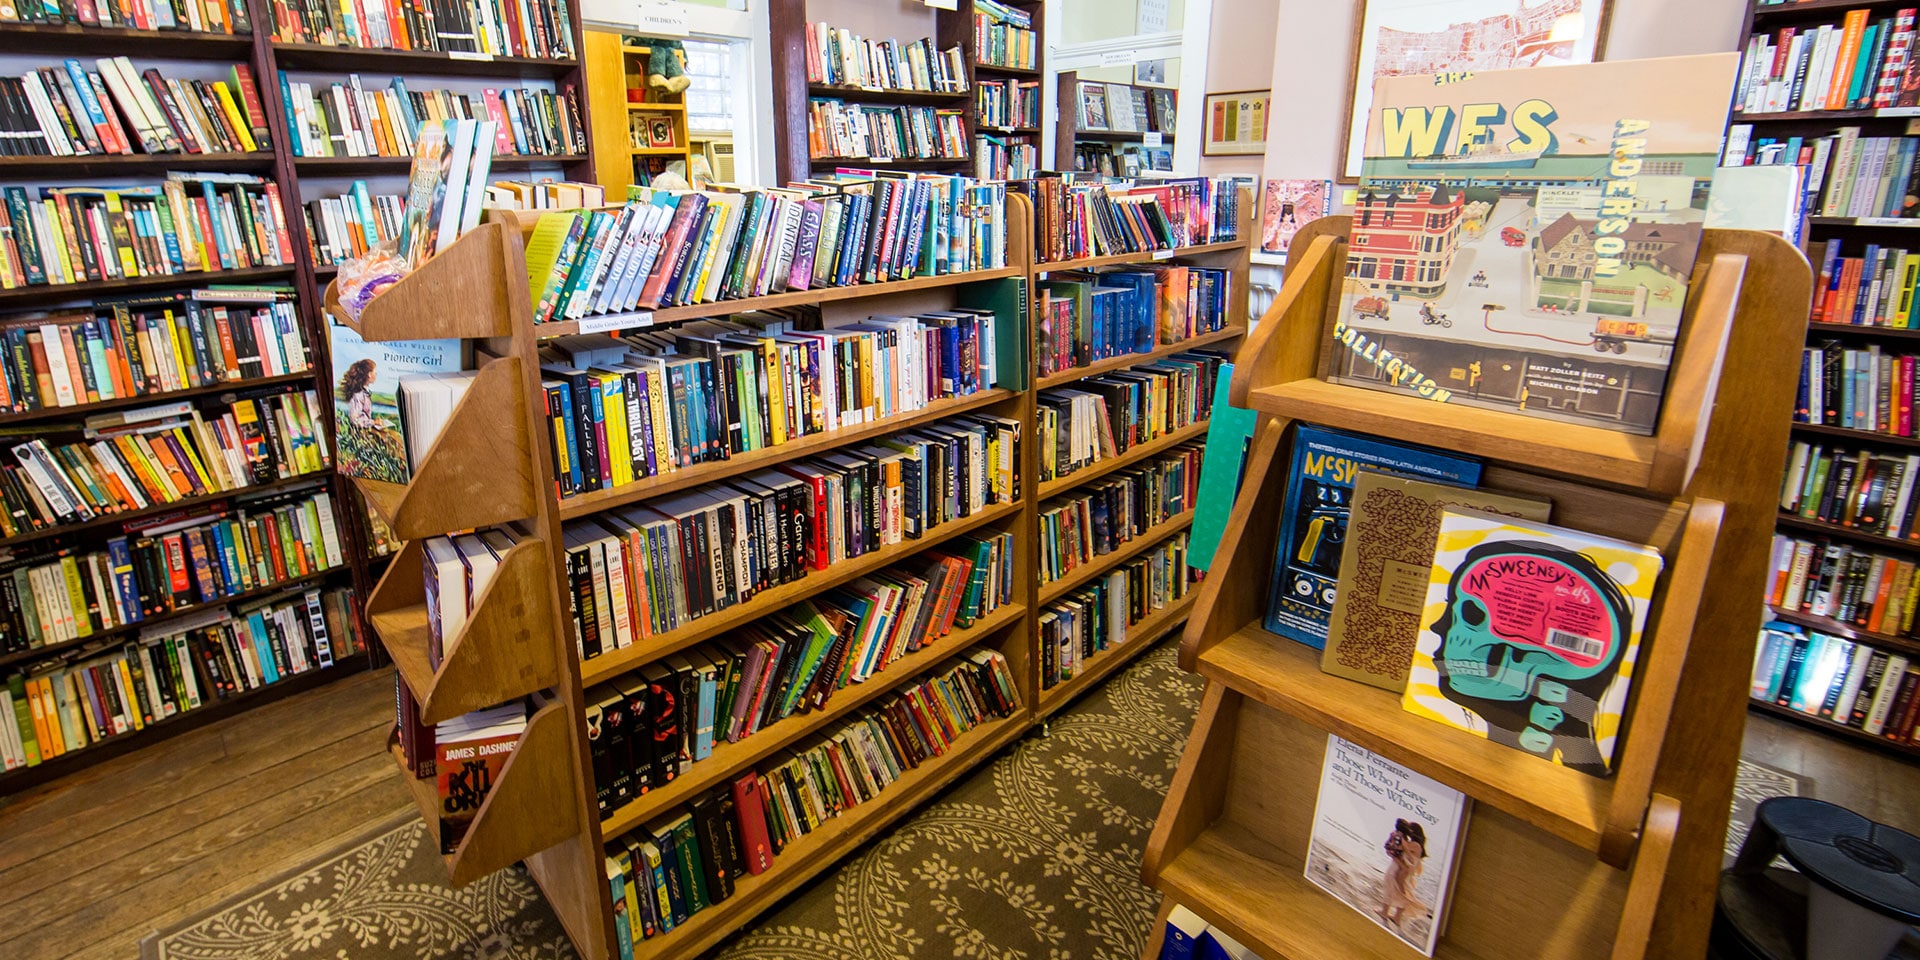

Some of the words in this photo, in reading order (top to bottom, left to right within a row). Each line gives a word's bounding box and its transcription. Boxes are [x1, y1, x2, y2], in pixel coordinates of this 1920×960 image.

[644, 16, 682, 25] CHILDREN'S
[1381, 99, 1559, 158] WES
[1594, 118, 1650, 279] ANDERSON
[748, 206, 761, 231] ascend
[778, 203, 801, 264] IDENTICAL
[383, 353, 421, 364] Pioneer
[422, 354, 443, 366] Girl
[411, 342, 444, 351] WILDER
[1333, 321, 1452, 403] COLLECTION
[1529, 364, 1549, 373] MATT
[1550, 367, 1580, 377] ZOLLER
[1581, 371, 1605, 381] SEITZ
[1529, 379, 1563, 391] MICHAEL
[578, 403, 596, 457] FALLEN
[628, 398, 645, 461] THRILL-OGY
[1378, 456, 1395, 465] FROM
[1395, 461, 1414, 469] LATIN
[1414, 464, 1442, 476] AMERICA
[767, 511, 775, 522] IN
[871, 485, 881, 529] UNIDENTIFIED
[767, 523, 776, 541] THE
[778, 518, 788, 540] Hunt
[793, 511, 806, 552] Game
[651, 550, 659, 570] LOWRY
[721, 541, 736, 590] PRODIGY
[737, 538, 751, 586] CHAMPION
[768, 542, 778, 570] AFTER
[780, 539, 790, 568] Killers
[711, 546, 725, 592] LEGEND
[1505, 587, 1523, 595] KELLY
[1571, 586, 1591, 604] 48
[1555, 605, 1579, 616] BOOTS
[1580, 611, 1601, 621] RILEY
[445, 747, 475, 761] JAMES
[1365, 750, 1409, 780] Ferrante
[448, 767, 492, 797] KIL
[1335, 748, 1365, 771] Those
[1367, 765, 1393, 786] Who
[1395, 781, 1427, 805] Leave
[1332, 763, 1352, 777] and
[1353, 770, 1384, 795] Those
[1386, 788, 1413, 811] Who
[1414, 804, 1439, 825] Stay
